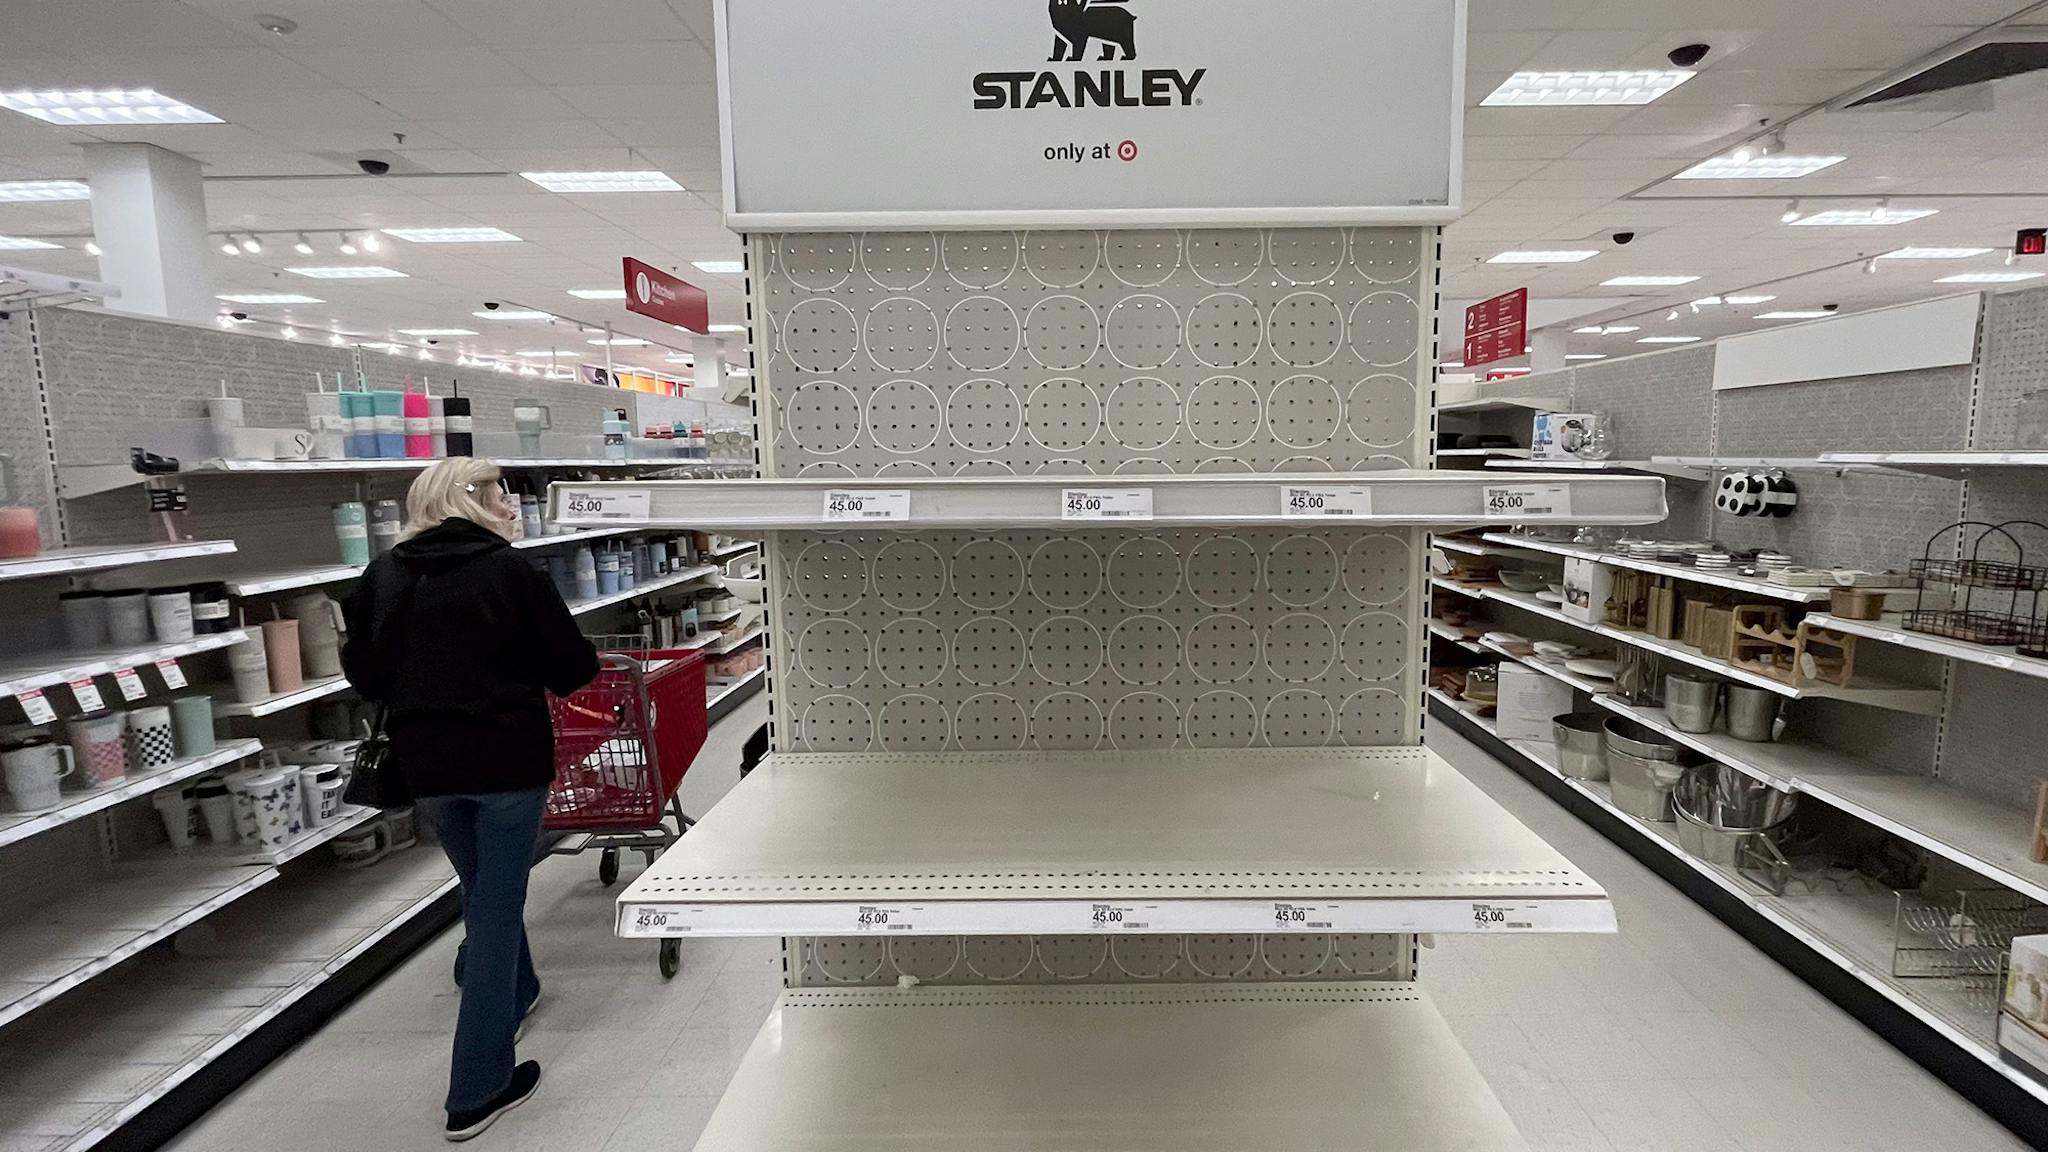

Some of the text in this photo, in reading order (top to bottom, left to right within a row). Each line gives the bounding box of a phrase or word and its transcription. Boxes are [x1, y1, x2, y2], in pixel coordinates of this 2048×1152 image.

[972, 68, 1207, 109] STANLEY
[1044, 142, 1111, 163] only at
[1467, 311, 1475, 331] 2
[1466, 342, 1473, 360] 1
[294, 433, 307, 456] S
[568, 500, 602, 512] 45.00
[829, 500, 863, 511] 45.00
[1067, 499, 1101, 510] 45.00
[1290, 497, 1324, 508] 45.00
[1489, 496, 1523, 508] 45.00
[636, 915, 667, 926] 45.00
[858, 913, 888, 924] 45.00
[1092, 911, 1123, 922] 45.00
[1275, 910, 1305, 922] 45.00
[1474, 911, 1505, 922] 45.00
